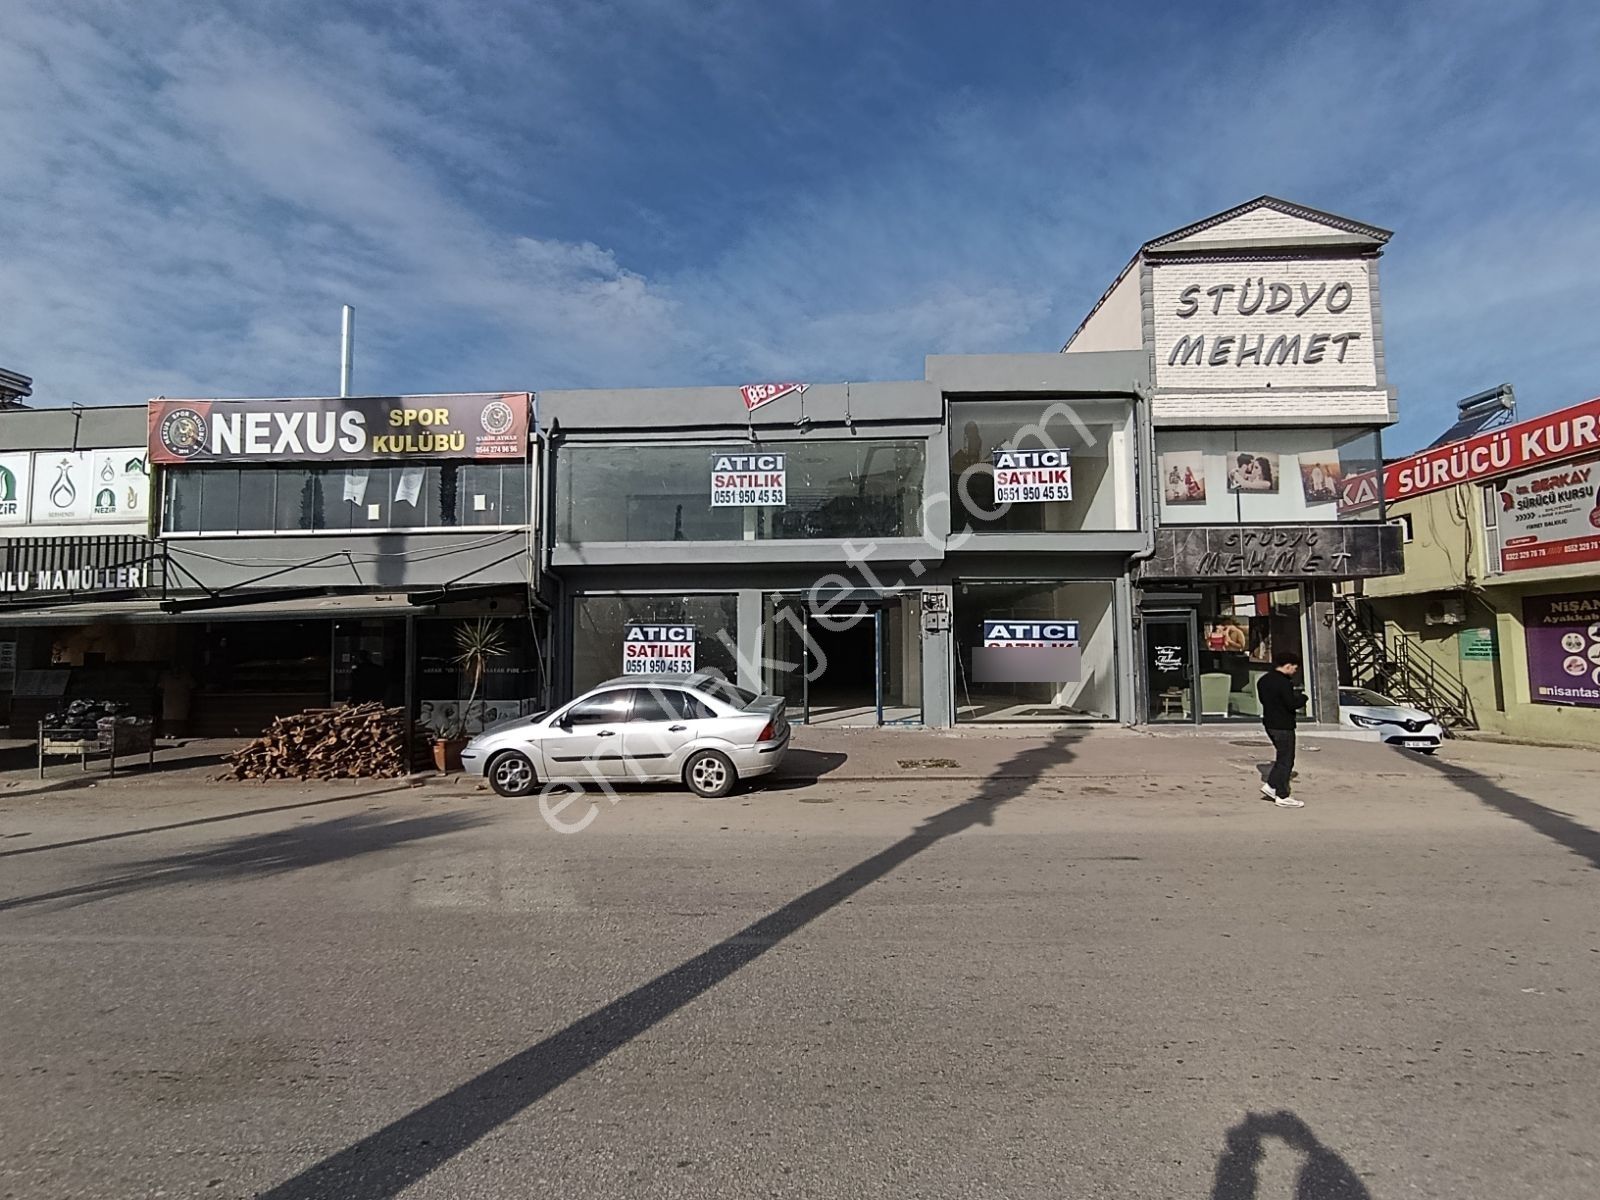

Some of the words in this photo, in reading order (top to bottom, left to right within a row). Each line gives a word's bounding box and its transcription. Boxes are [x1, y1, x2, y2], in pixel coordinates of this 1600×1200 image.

[1176, 277, 1353, 317] STÜDYO
[1168, 332, 1362, 366] MEHMET
[389, 408, 449, 428] SPOR
[212, 410, 366, 454] NEXUS
[373, 430, 466, 453] KULÜBÜ
[996, 451, 1069, 468] ATICI
[1398, 432, 1511, 493] SÜRÜCÜ
[1521, 414, 1600, 461] KUR
[714, 456, 783, 471] ATICI
[714, 474, 782, 488] SATILIK
[997, 469, 1068, 485] SATILIK
[714, 490, 736, 504] 0551
[738, 490, 756, 503] 950
[758, 490, 769, 503] 45
[771, 489, 783, 503] 53
[997, 488, 1020, 501] 0551
[1022, 487, 1040, 500] 950
[1042, 487, 1055, 500] 45
[1056, 486, 1069, 499] 53
[1557, 485, 1594, 504] KURSU
[1196, 551, 1351, 573] MEHMET
[38, 561, 148, 590] MAMÜLLERİ
[1551, 599, 1600, 613] NiŞA
[626, 627, 693, 641] ATICI
[987, 625, 1076, 639] ATICI
[626, 645, 692, 658] SATILIK
[626, 660, 647, 673] 0551
[649, 660, 666, 673] 950
[667, 660, 679, 673] 45
[680, 660, 692, 673] 53
[1547, 686, 1600, 698] nisantas
